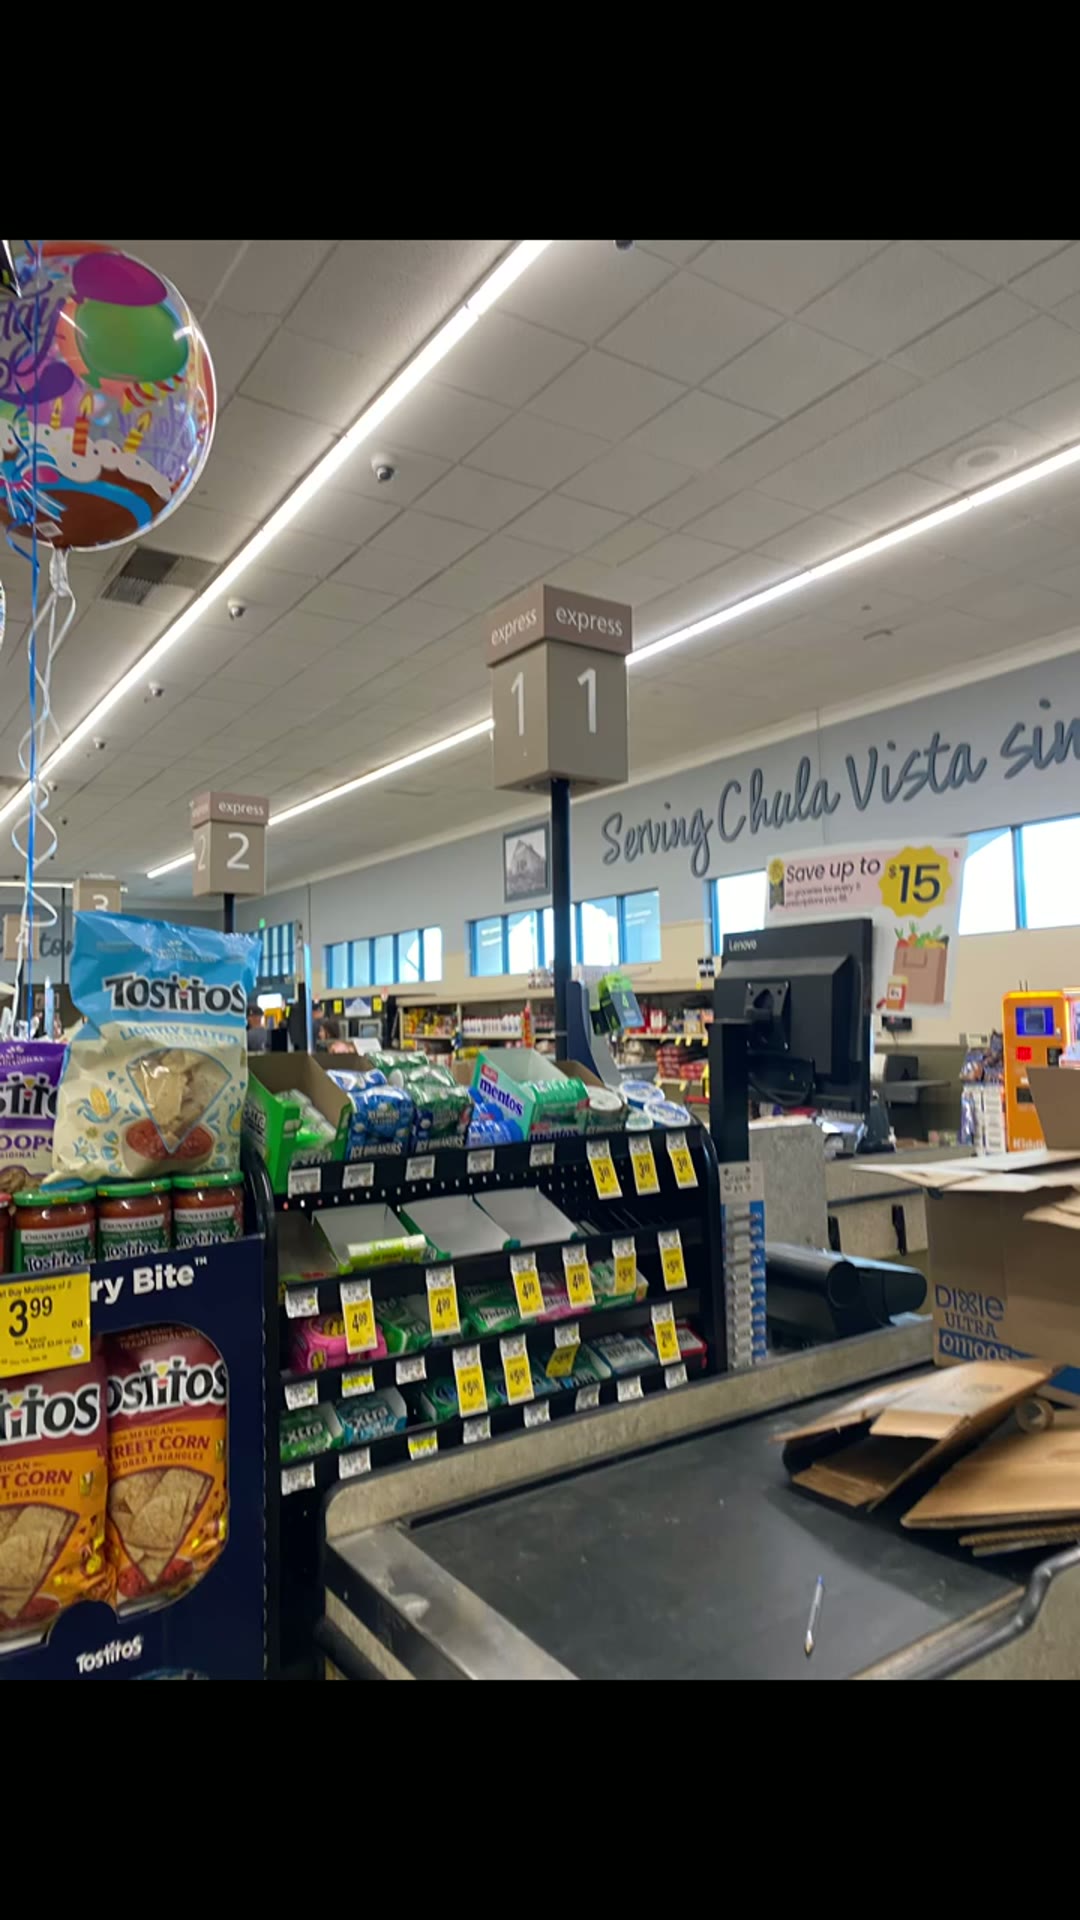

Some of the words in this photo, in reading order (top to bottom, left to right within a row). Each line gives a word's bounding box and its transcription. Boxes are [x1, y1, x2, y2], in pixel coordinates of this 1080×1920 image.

[491, 608, 537, 646] express
[556, 606, 623, 637] express
[511, 671, 524, 736] 1
[577, 667, 596, 733] 1
[218, 801, 264, 816] express
[601, 802, 714, 878] Serving
[717, 756, 841, 843] Chula
[845, 732, 987, 811] Vista
[227, 832, 250, 869] 2
[786, 863, 826, 884] Save
[829, 861, 855, 883] up
[860, 857, 881, 876] to
[728, 938, 757, 951] Lenovo
[479, 1077, 523, 1118] mentos
[133, 1263, 195, 1295] Bite
[71, 1319, 84, 1329] ea
[944, 1311, 998, 1339] ULTRA
[159, 1434, 210, 1450] CORN
[14, 1469, 73, 1487] CORN
[76, 1634, 143, 1674] Tostitos
